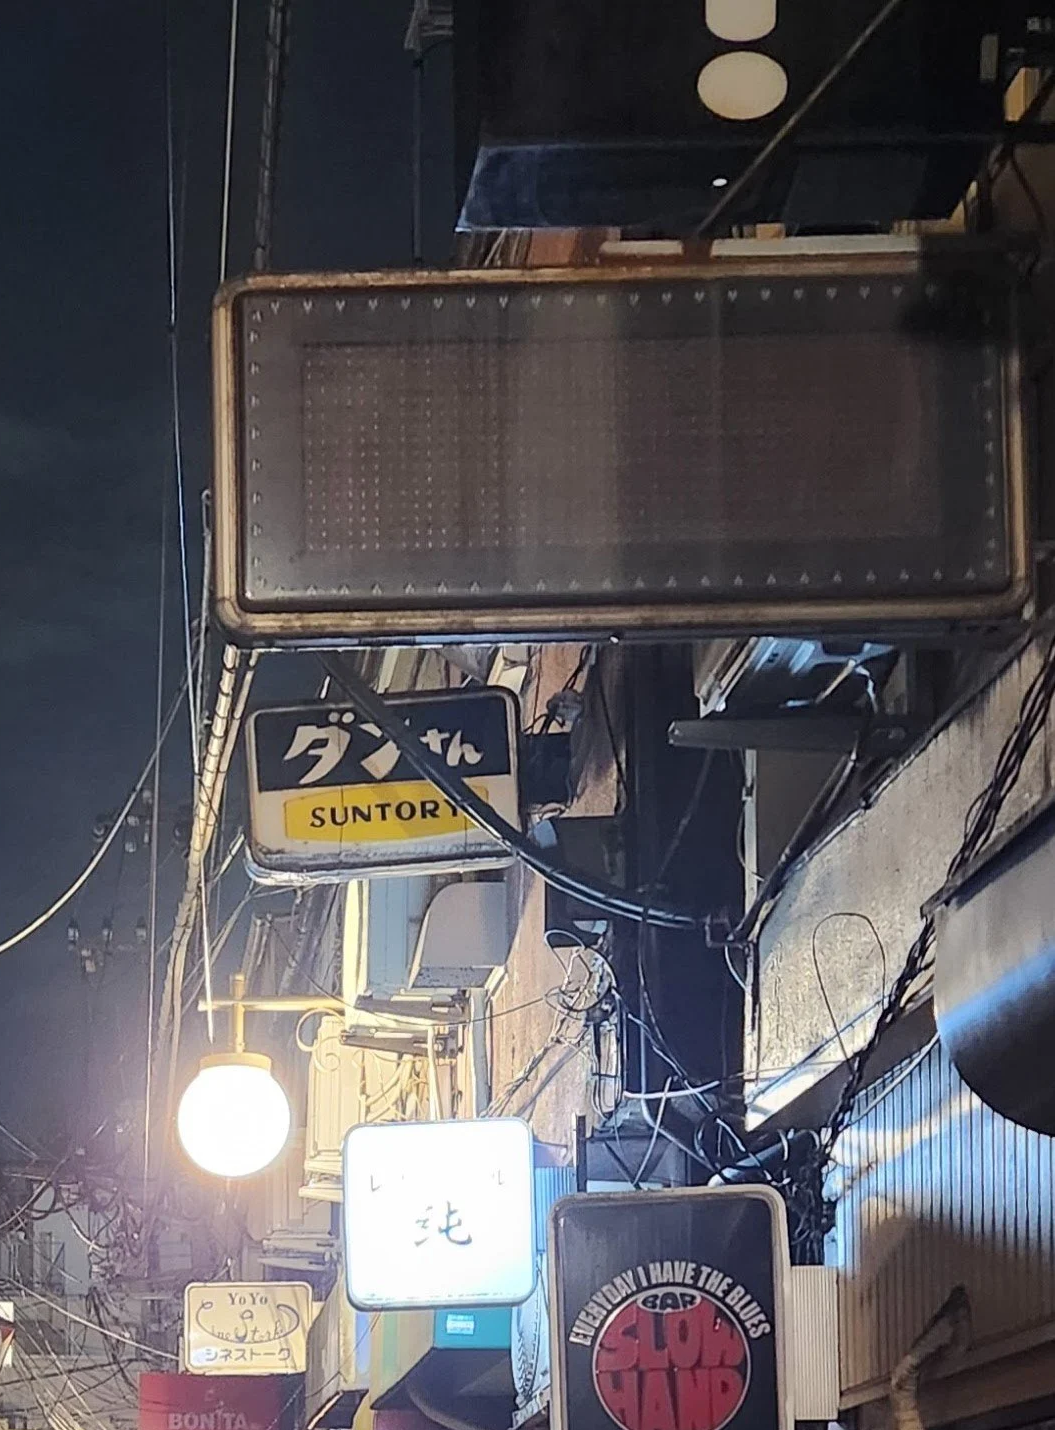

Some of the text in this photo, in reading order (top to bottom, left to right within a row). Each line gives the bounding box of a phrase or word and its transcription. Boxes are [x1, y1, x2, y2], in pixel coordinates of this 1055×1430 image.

[309, 799, 459, 828] SUNTORY
[569, 1260, 771, 1347] EVERYDAY I HAVE THE BLUES
[641, 1292, 697, 1311] BAR
[597, 1295, 745, 1371] SLOW
[205, 1347, 291, 1362] シネストーク
